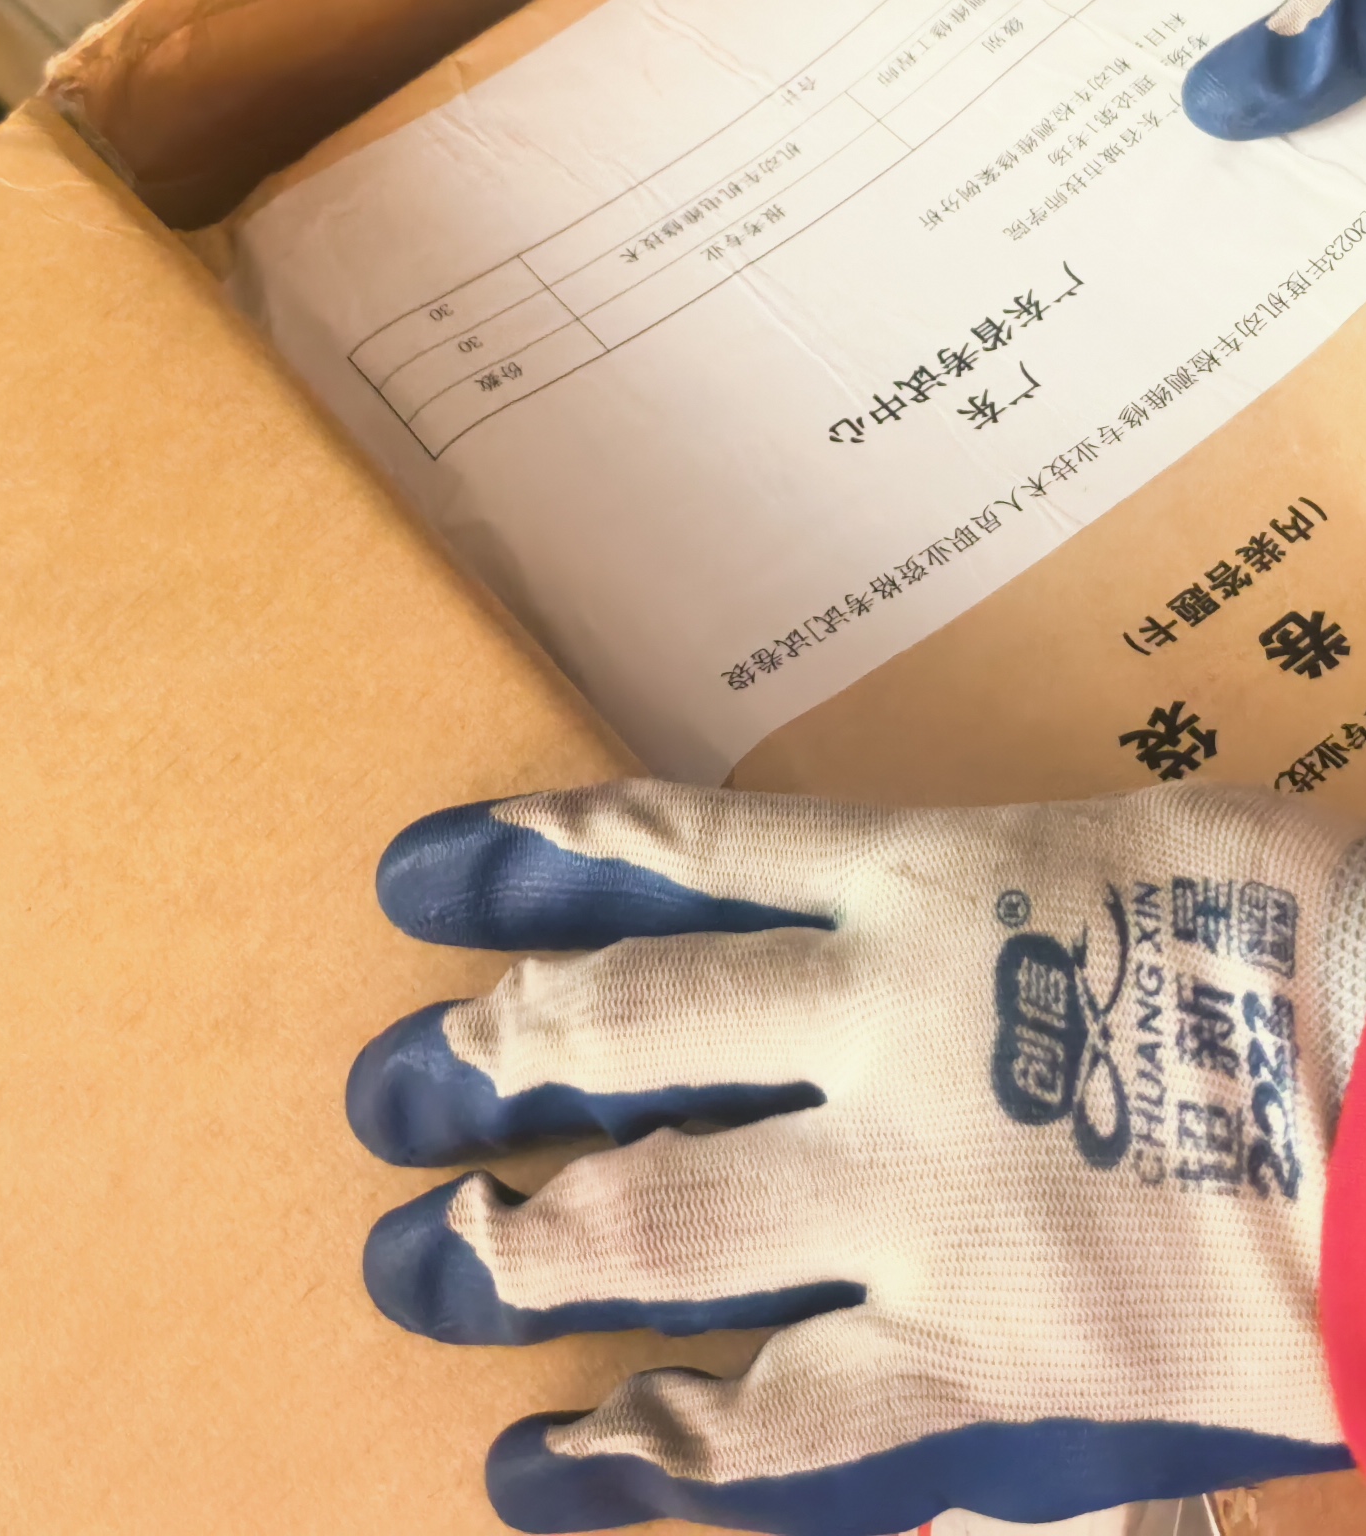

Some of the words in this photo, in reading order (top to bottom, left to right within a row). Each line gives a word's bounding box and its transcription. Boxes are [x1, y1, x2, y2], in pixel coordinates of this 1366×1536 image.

[980, 17, 1025, 55] 级别
[427, 302, 455, 323] 30
[456, 334, 485, 354] 30
[473, 360, 524, 393] 份数
[829, 261, 1084, 443] 广东省考试中心
[957, 361, 1041, 429] 广东
[1123, 497, 1327, 655] (内装答题卡)
[1133, 880, 1164, 952] XIN
[1133, 962, 1168, 1186] CHUANG
